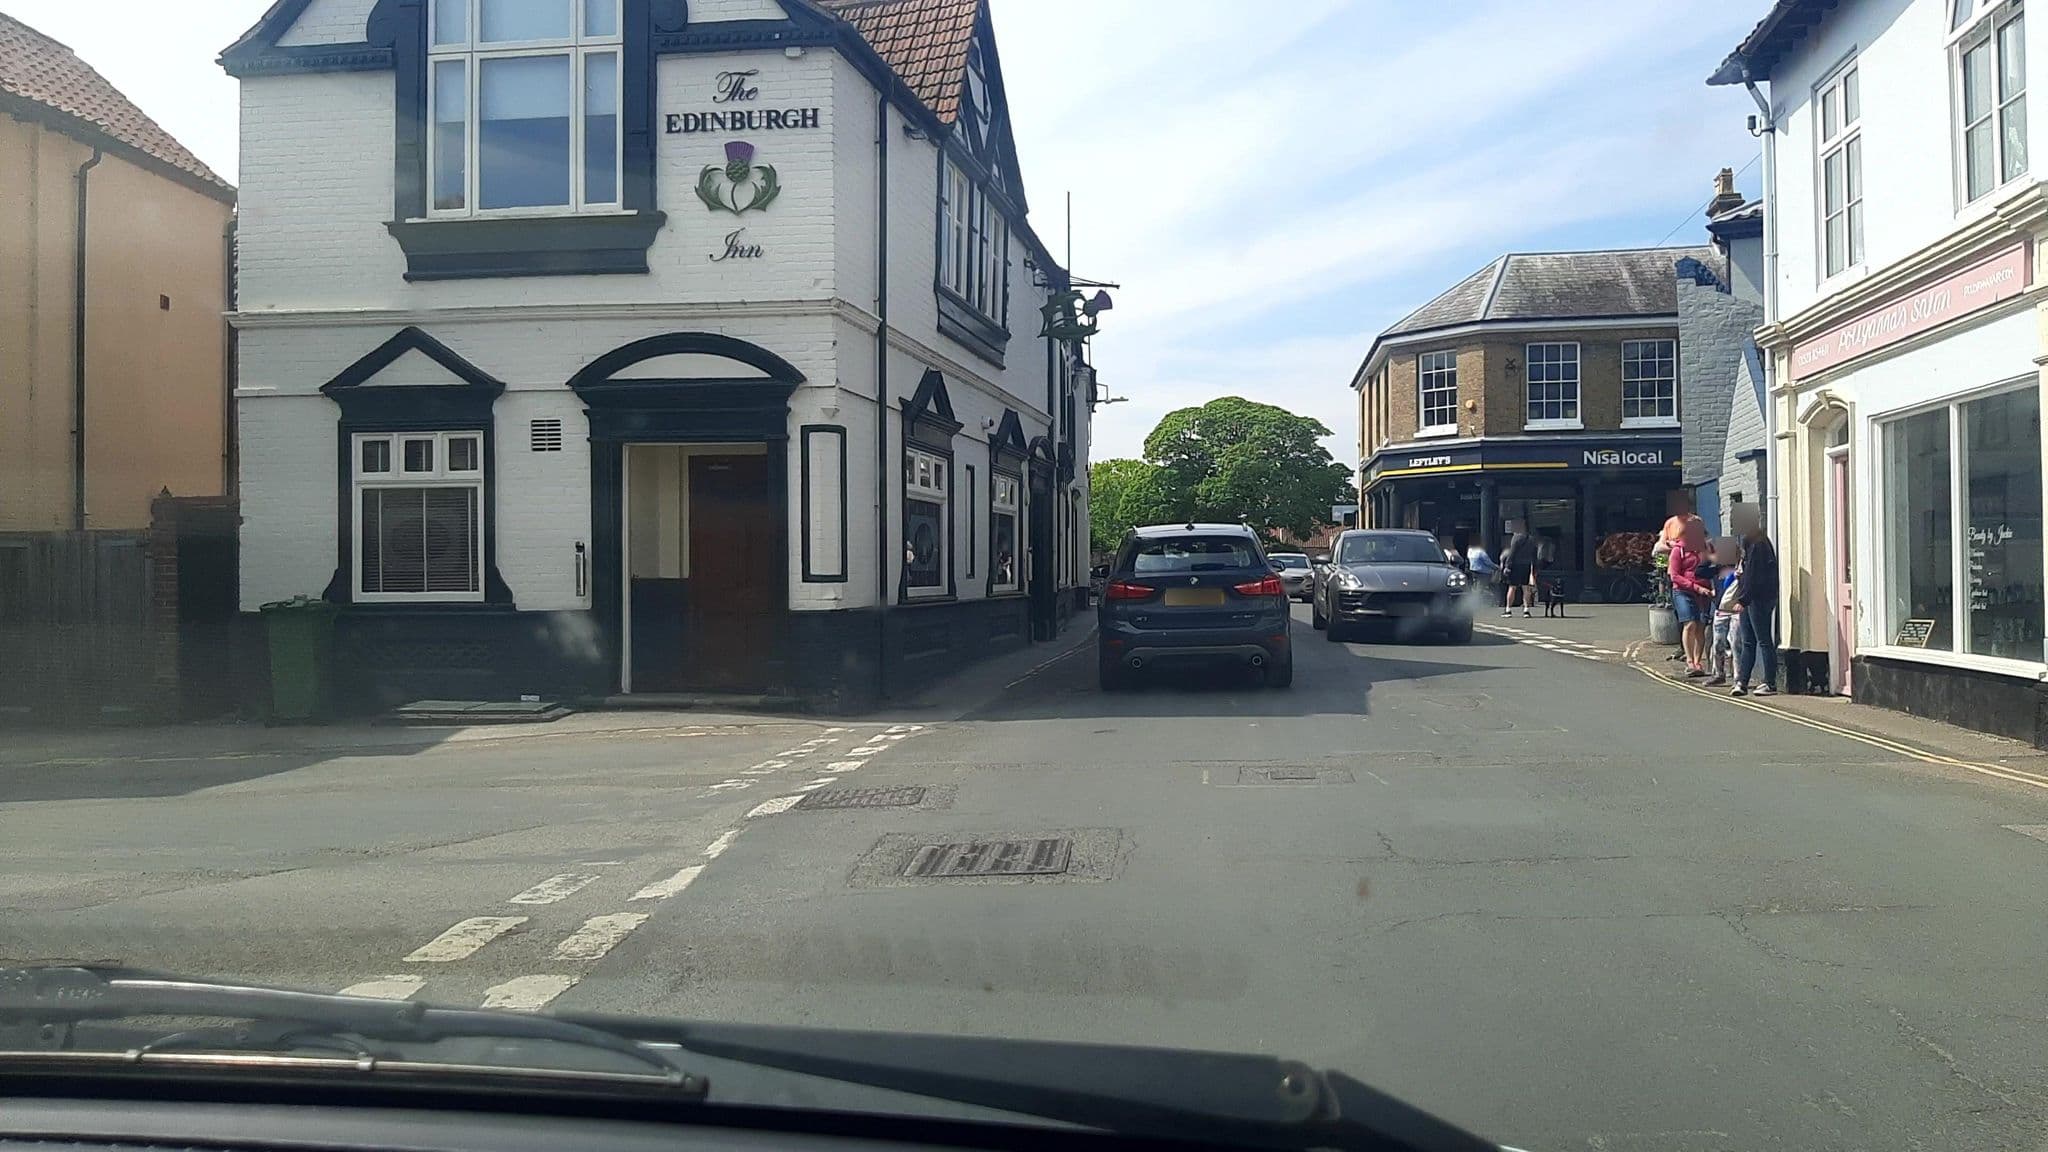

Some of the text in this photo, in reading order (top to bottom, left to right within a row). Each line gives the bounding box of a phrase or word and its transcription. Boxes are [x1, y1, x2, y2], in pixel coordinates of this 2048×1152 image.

[713, 69, 759, 103] The
[665, 108, 819, 134] EDINBURGH
[709, 227, 765, 262] Inn
[1911, 289, 1951, 322] Salon
[1583, 449, 1663, 465] Nisa local
